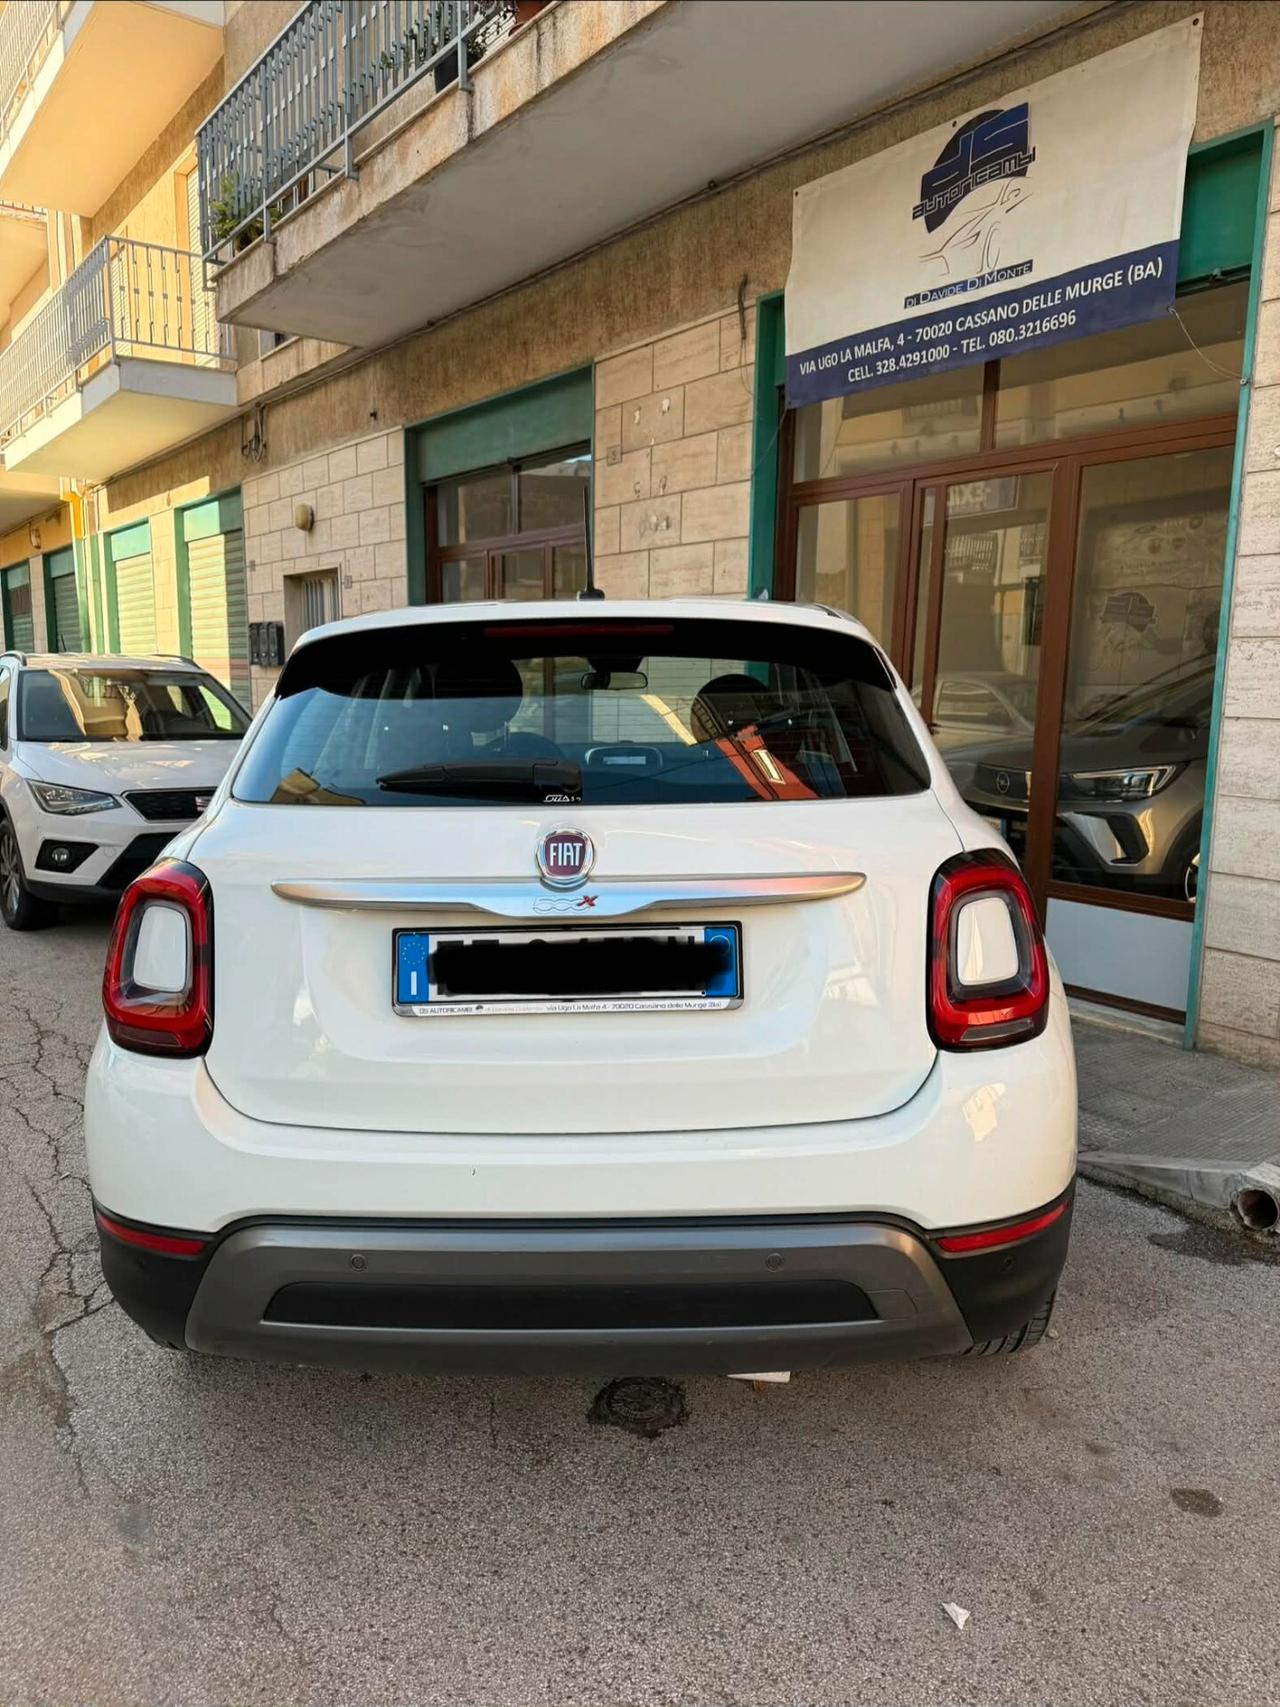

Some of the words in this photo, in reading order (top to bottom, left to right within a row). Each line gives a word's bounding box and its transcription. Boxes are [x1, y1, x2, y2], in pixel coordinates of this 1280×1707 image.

[800, 362, 816, 376] VIA
[818, 355, 838, 370] UGO
[840, 349, 852, 363] LA
[854, 337, 895, 360] MALFA,
[897, 333, 905, 346] 4
[915, 320, 953, 343] 70020
[956, 302, 1019, 333] CASSANO
[1022, 288, 1062, 315] DELLE
[1065, 270, 1123, 302] MURGE
[1127, 257, 1163, 285] (BA)
[848, 366, 874, 383] CELL.
[876, 344, 950, 376] 328.4291000
[961, 335, 986, 354] TEL.
[989, 309, 1077, 346] 080.3216696
[550, 842, 583, 867] FIAT
[411, 971, 417, 995] I
